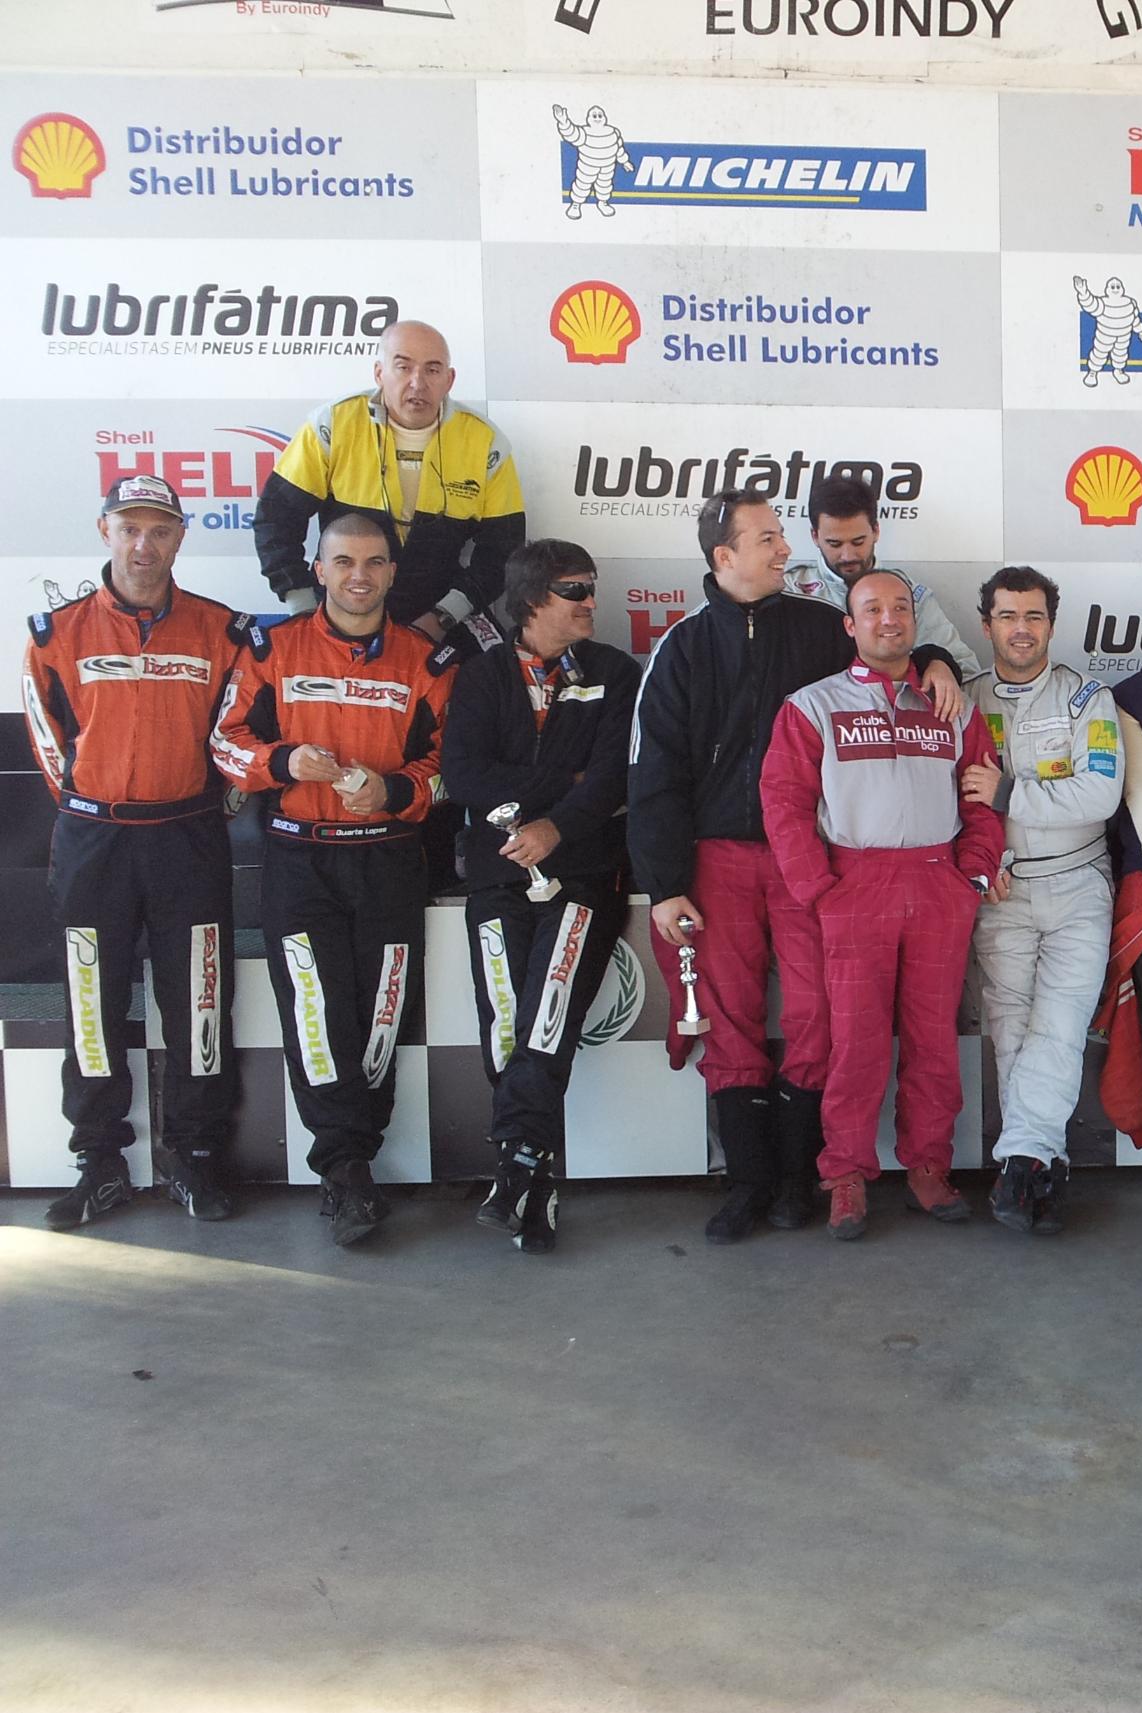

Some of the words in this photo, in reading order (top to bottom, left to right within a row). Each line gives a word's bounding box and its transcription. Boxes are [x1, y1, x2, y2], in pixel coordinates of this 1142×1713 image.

[236, 1, 256, 16] By
[705, 0, 1014, 38] EUROINDY
[126, 126, 343, 157] Distribuidor
[128, 168, 216, 197] Shell
[230, 169, 415, 198] Lubricants
[633, 155, 918, 193] MICHELIN
[662, 294, 872, 326] Distribuidor
[47, 341, 170, 356] ESPECIALISTAS
[173, 342, 199, 355] EM
[201, 342, 254, 356] PNEUS
[258, 342, 269, 356] E
[271, 342, 381, 356] LUBRIFICANT
[662, 334, 748, 363] Shell
[761, 336, 940, 367] Lubricants
[95, 430, 154, 445] Shell
[626, 588, 685, 604] Shell
[837, 724, 951, 745] Millennium
[920, 740, 940, 753] bcp
[78, 966, 105, 1072] PLADUR
[297, 971, 330, 1077] PLADUR
